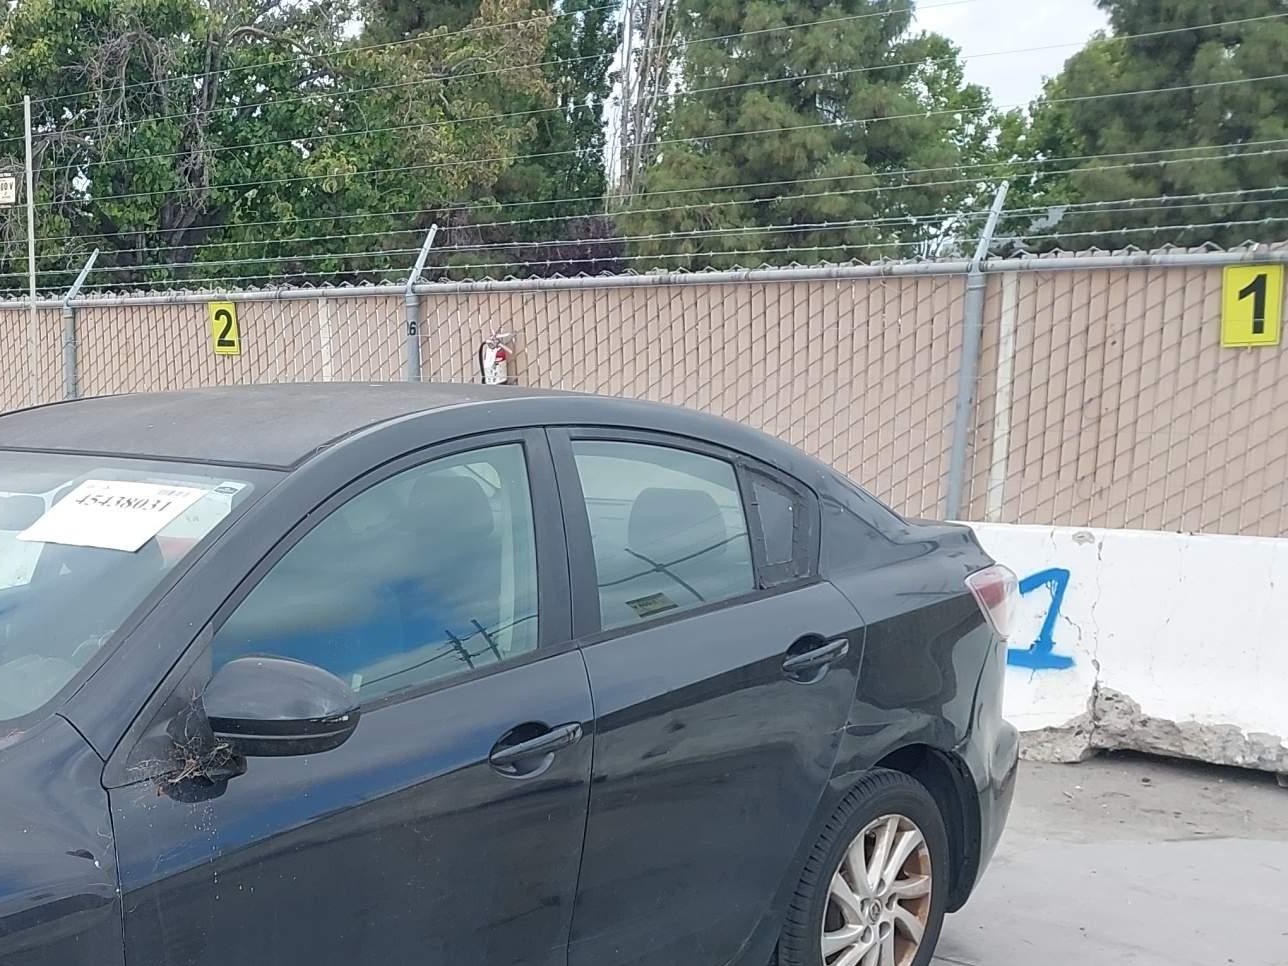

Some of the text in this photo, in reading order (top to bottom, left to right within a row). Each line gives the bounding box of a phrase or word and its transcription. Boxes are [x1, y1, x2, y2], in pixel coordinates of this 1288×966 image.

[214, 309, 235, 347] 2
[1238, 273, 1267, 334] 1
[75, 494, 173, 512] 45438031
[1007, 568, 1076, 670] 1
